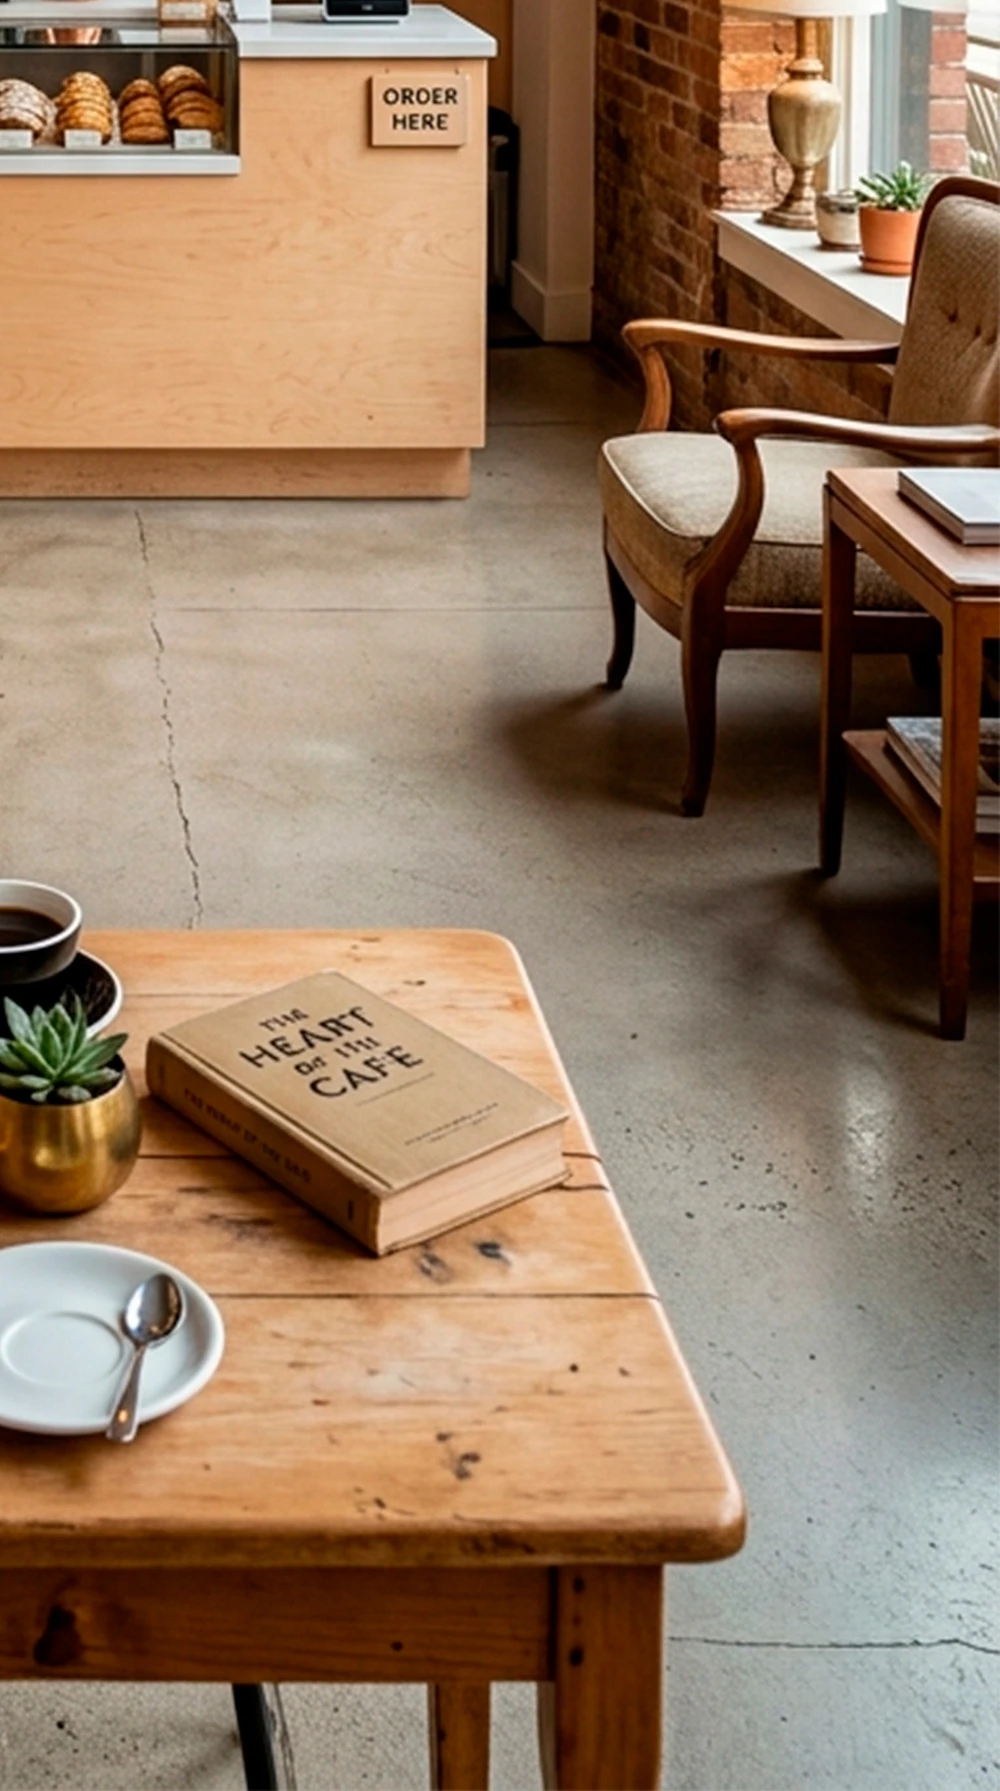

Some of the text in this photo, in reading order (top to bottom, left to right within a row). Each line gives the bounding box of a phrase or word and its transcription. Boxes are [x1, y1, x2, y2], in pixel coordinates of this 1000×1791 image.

[392, 113, 449, 130] HERE
[239, 1006, 374, 1069] HEART
[309, 1045, 424, 1098] CAFE
